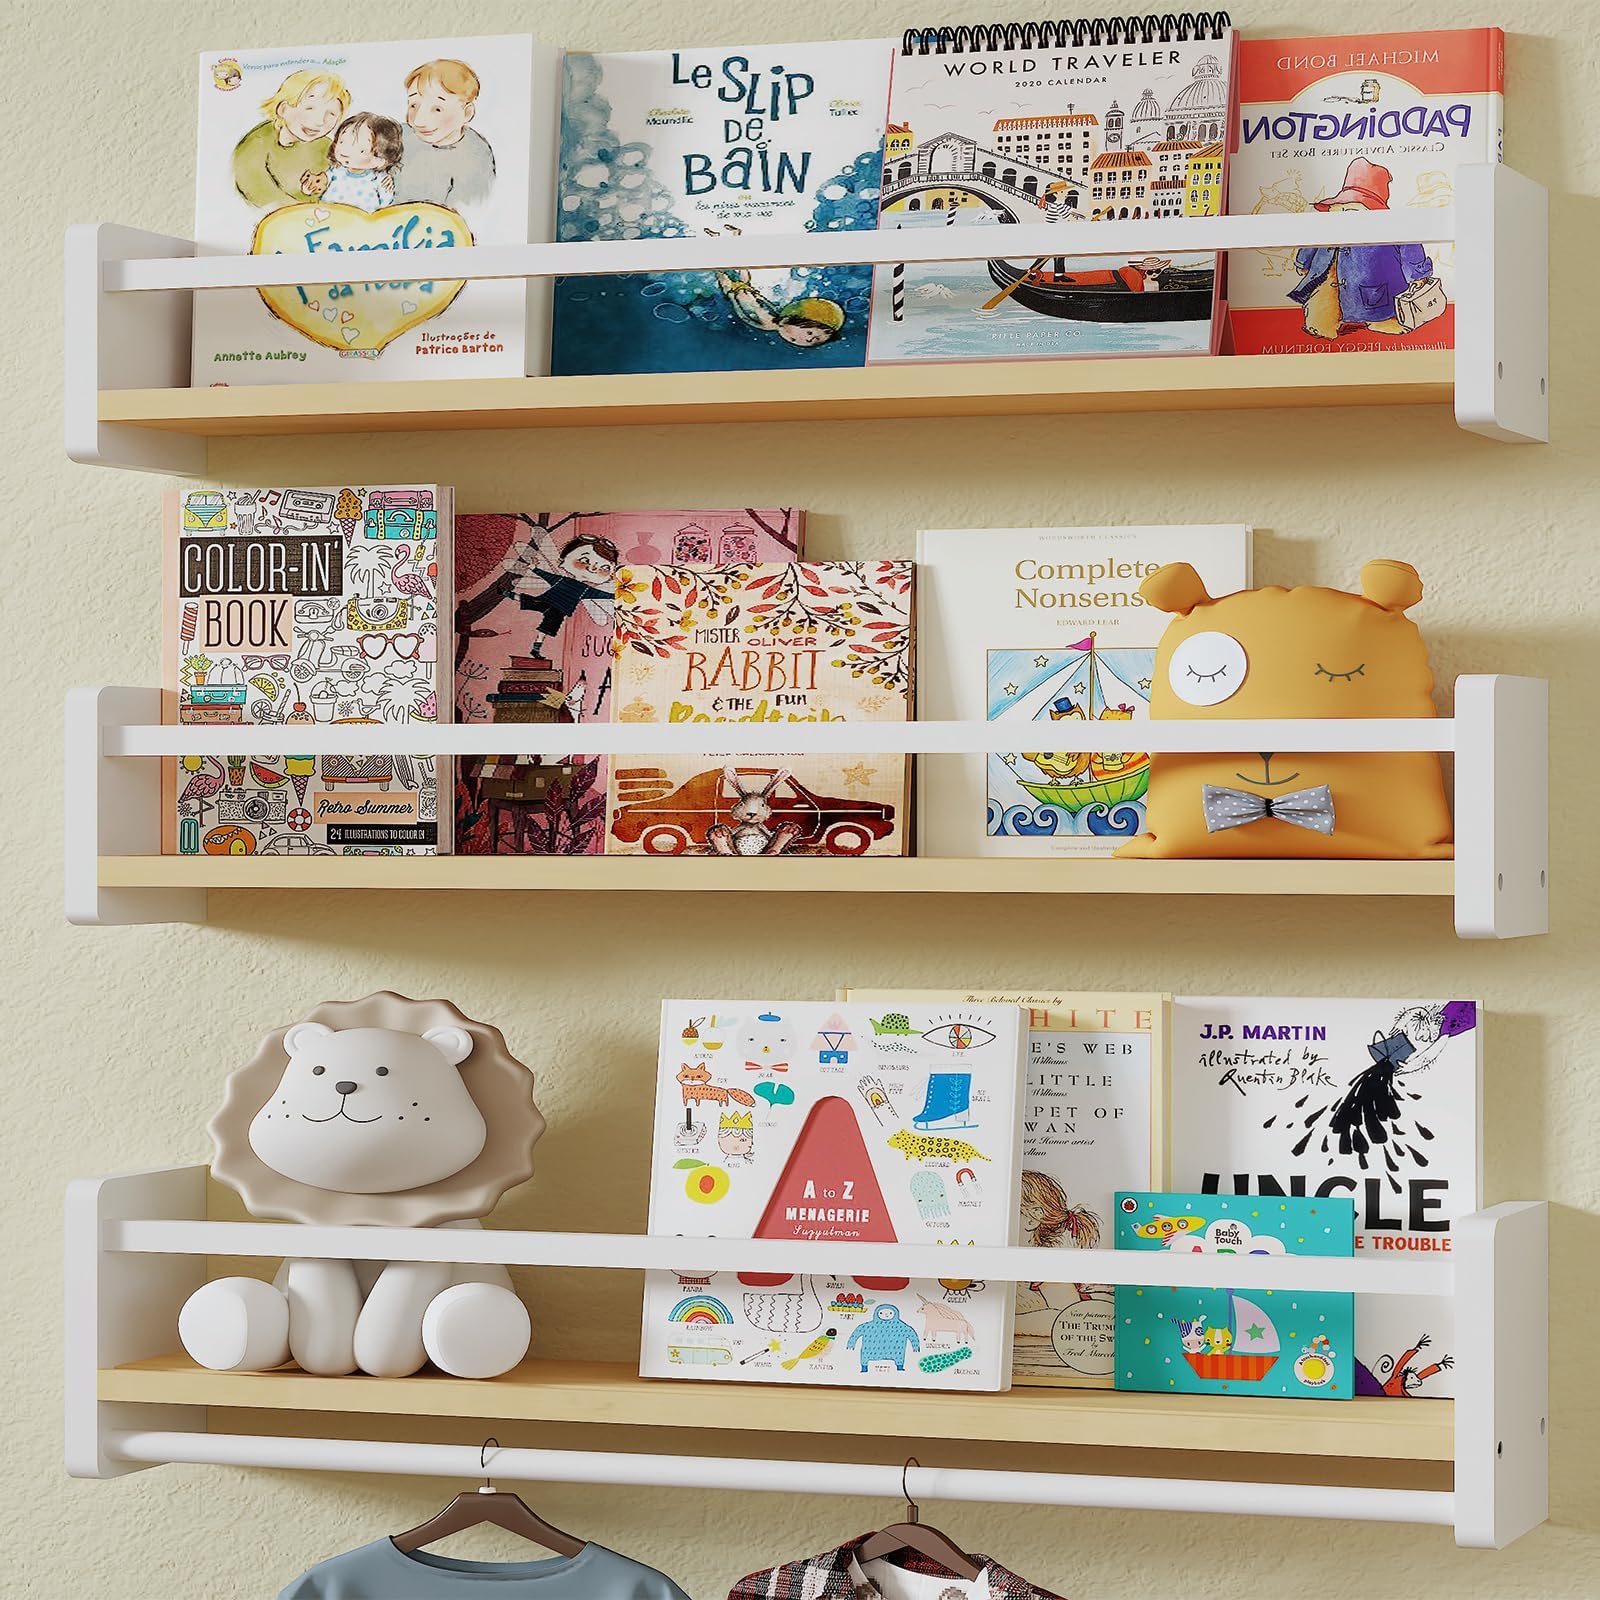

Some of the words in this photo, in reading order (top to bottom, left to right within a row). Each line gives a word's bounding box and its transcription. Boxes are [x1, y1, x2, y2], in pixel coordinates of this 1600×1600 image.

[671, 53, 712, 89] Le
[943, 58, 1037, 77] WORLD
[1051, 50, 1182, 71] TRAVELER
[1014, 79, 1043, 88] 2020
[1047, 76, 1108, 86] CALENDAR
[421, 332, 480, 342] Ilustrações
[483, 331, 496, 340] de
[213, 350, 262, 362] Annette
[265, 350, 307, 362] Aubrey
[415, 343, 459, 355] Patrice
[461, 342, 504, 353] Barton
[1015, 588, 1154, 609] Nonsens
[204, 599, 289, 648] BOOK
[694, 627, 741, 644] MISTER
[747, 637, 817, 647] OLIVER
[581, 634, 614, 658] SUG
[681, 645, 826, 692] RABBIT
[726, 698, 754, 711] THE
[317, 799, 352, 818] Retro
[354, 799, 414, 815] Summer
[330, 828, 342, 840] 24
[389, 829, 398, 840] TO
[1029, 1007, 1152, 1030] HITE
[1199, 1023, 1235, 1040] J.P.
[1242, 1024, 1327, 1041] MARTIN
[1031, 1042, 1067, 1054] E'S
[1082, 1042, 1133, 1055] WEB
[1198, 1048, 1292, 1068] illustrated
[1301, 1046, 1329, 1066] by
[1218, 1068, 1284, 1097] Quentin
[1276, 1066, 1339, 1091] Blake
[1093, 1107, 1124, 1119] OF
[1024, 1121, 1077, 1133] WAN
[802, 1179, 817, 1199] A
[823, 1188, 836, 1199] to
[842, 1180, 855, 1200] Z
[785, 1207, 870, 1223] MENAGERIE
[1214, 1236, 1243, 1246] Touch
[1215, 1228, 1240, 1239] Baby
[1371, 1235, 1453, 1252] TROUBLE
[1059, 1320, 1081, 1331] THE
[1083, 1320, 1115, 1331] TRUM
[1098, 1333, 1115, 1343] SW
